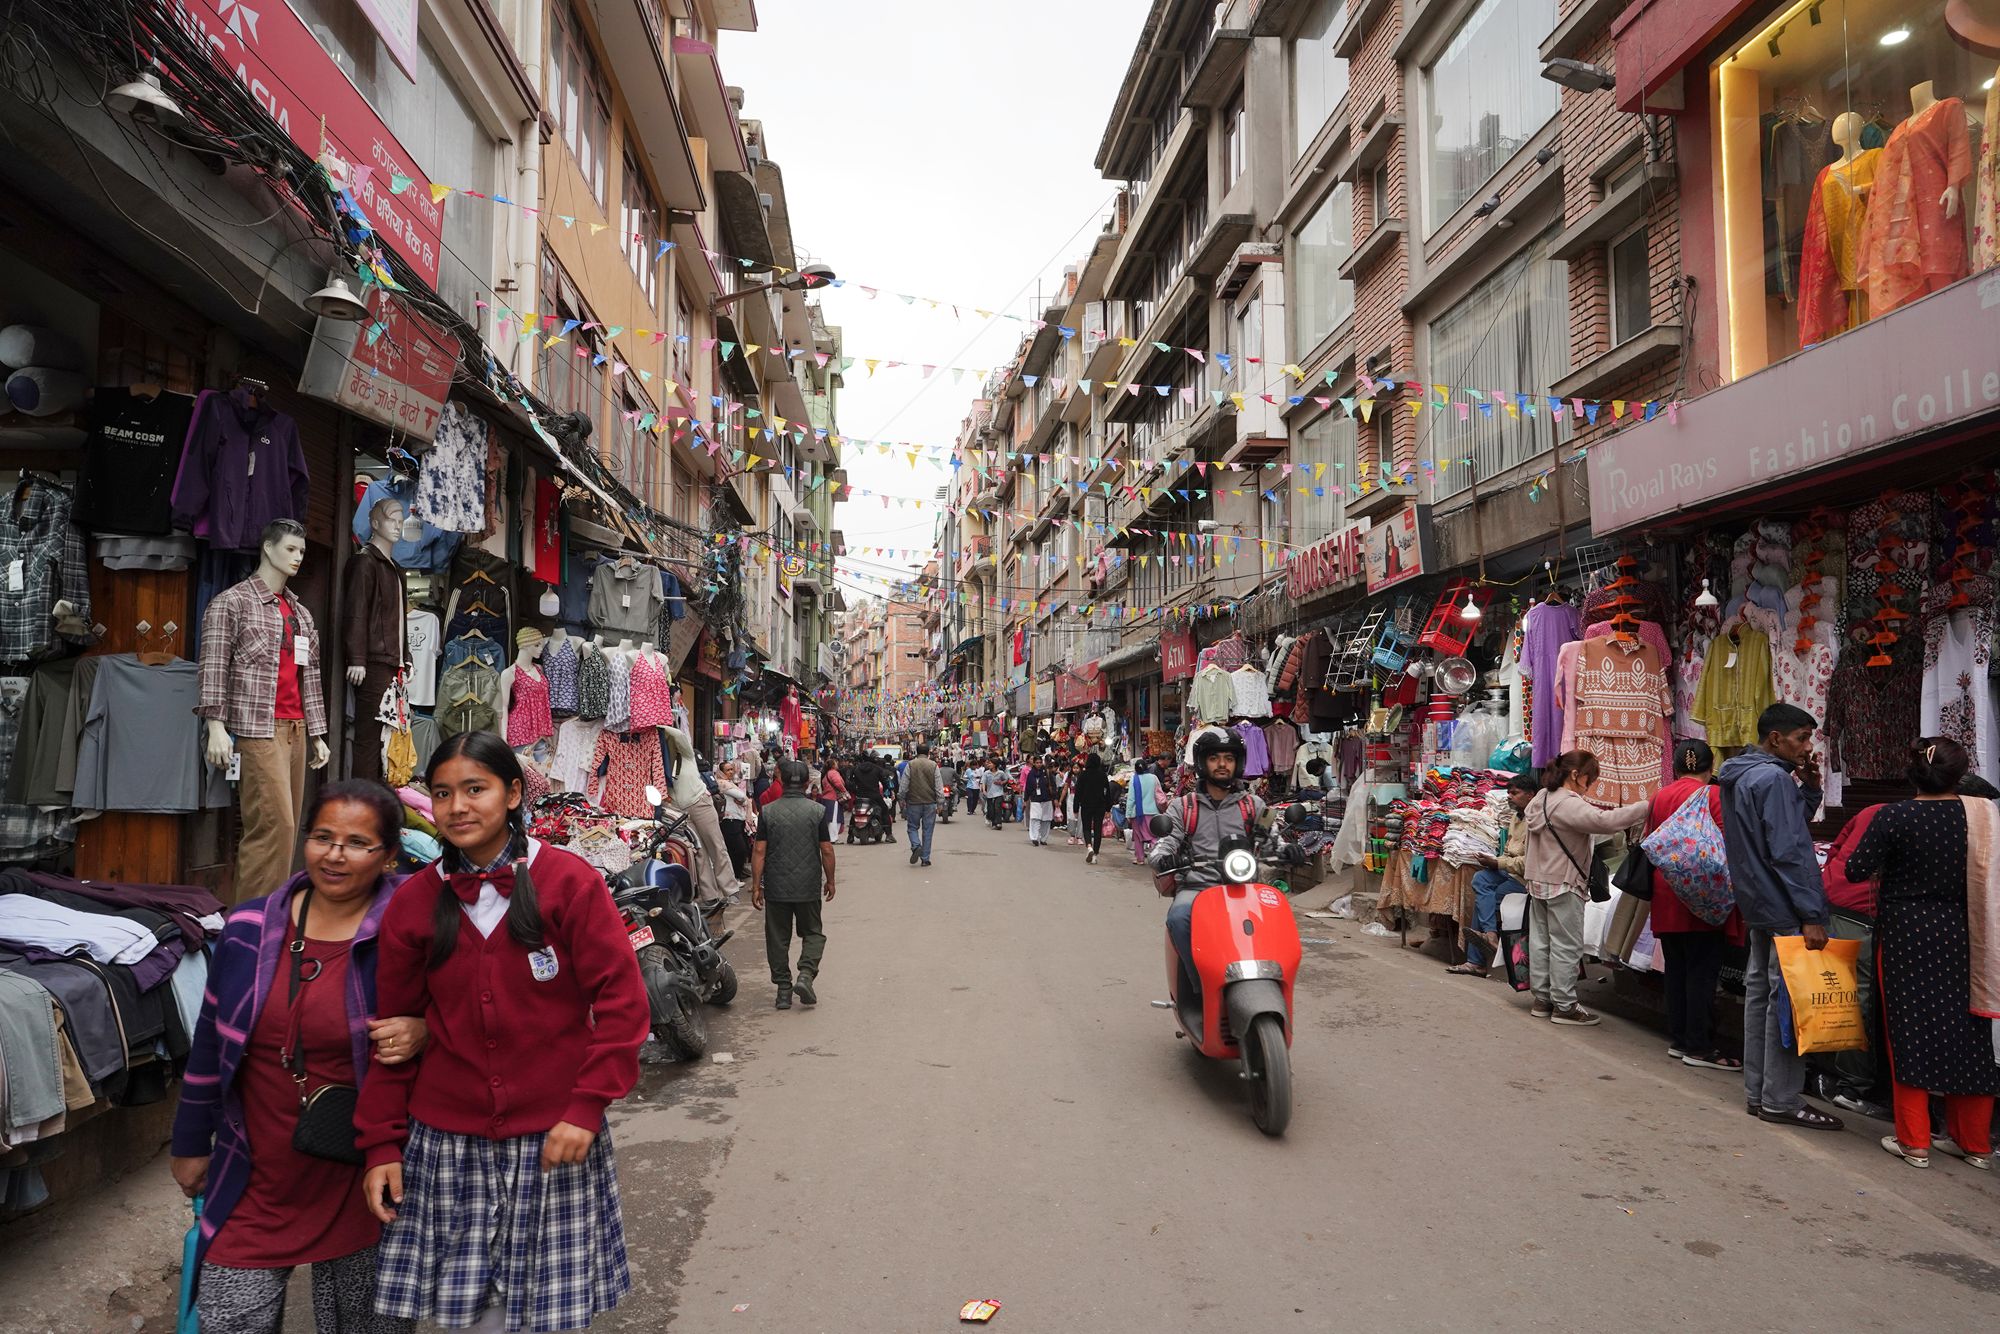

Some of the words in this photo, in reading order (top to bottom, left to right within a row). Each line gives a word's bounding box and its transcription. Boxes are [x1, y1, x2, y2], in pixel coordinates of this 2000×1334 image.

[376, 195, 404, 239] एशिया
[399, 400, 420, 424] बाटो
[104, 426, 133, 439] BEAM
[135, 432, 164, 443] COSM
[1608, 467, 1665, 514] Royal
[1670, 456, 1718, 491] Rays
[1749, 411, 1876, 478] Fashion
[1168, 645, 1185, 669] ATM
